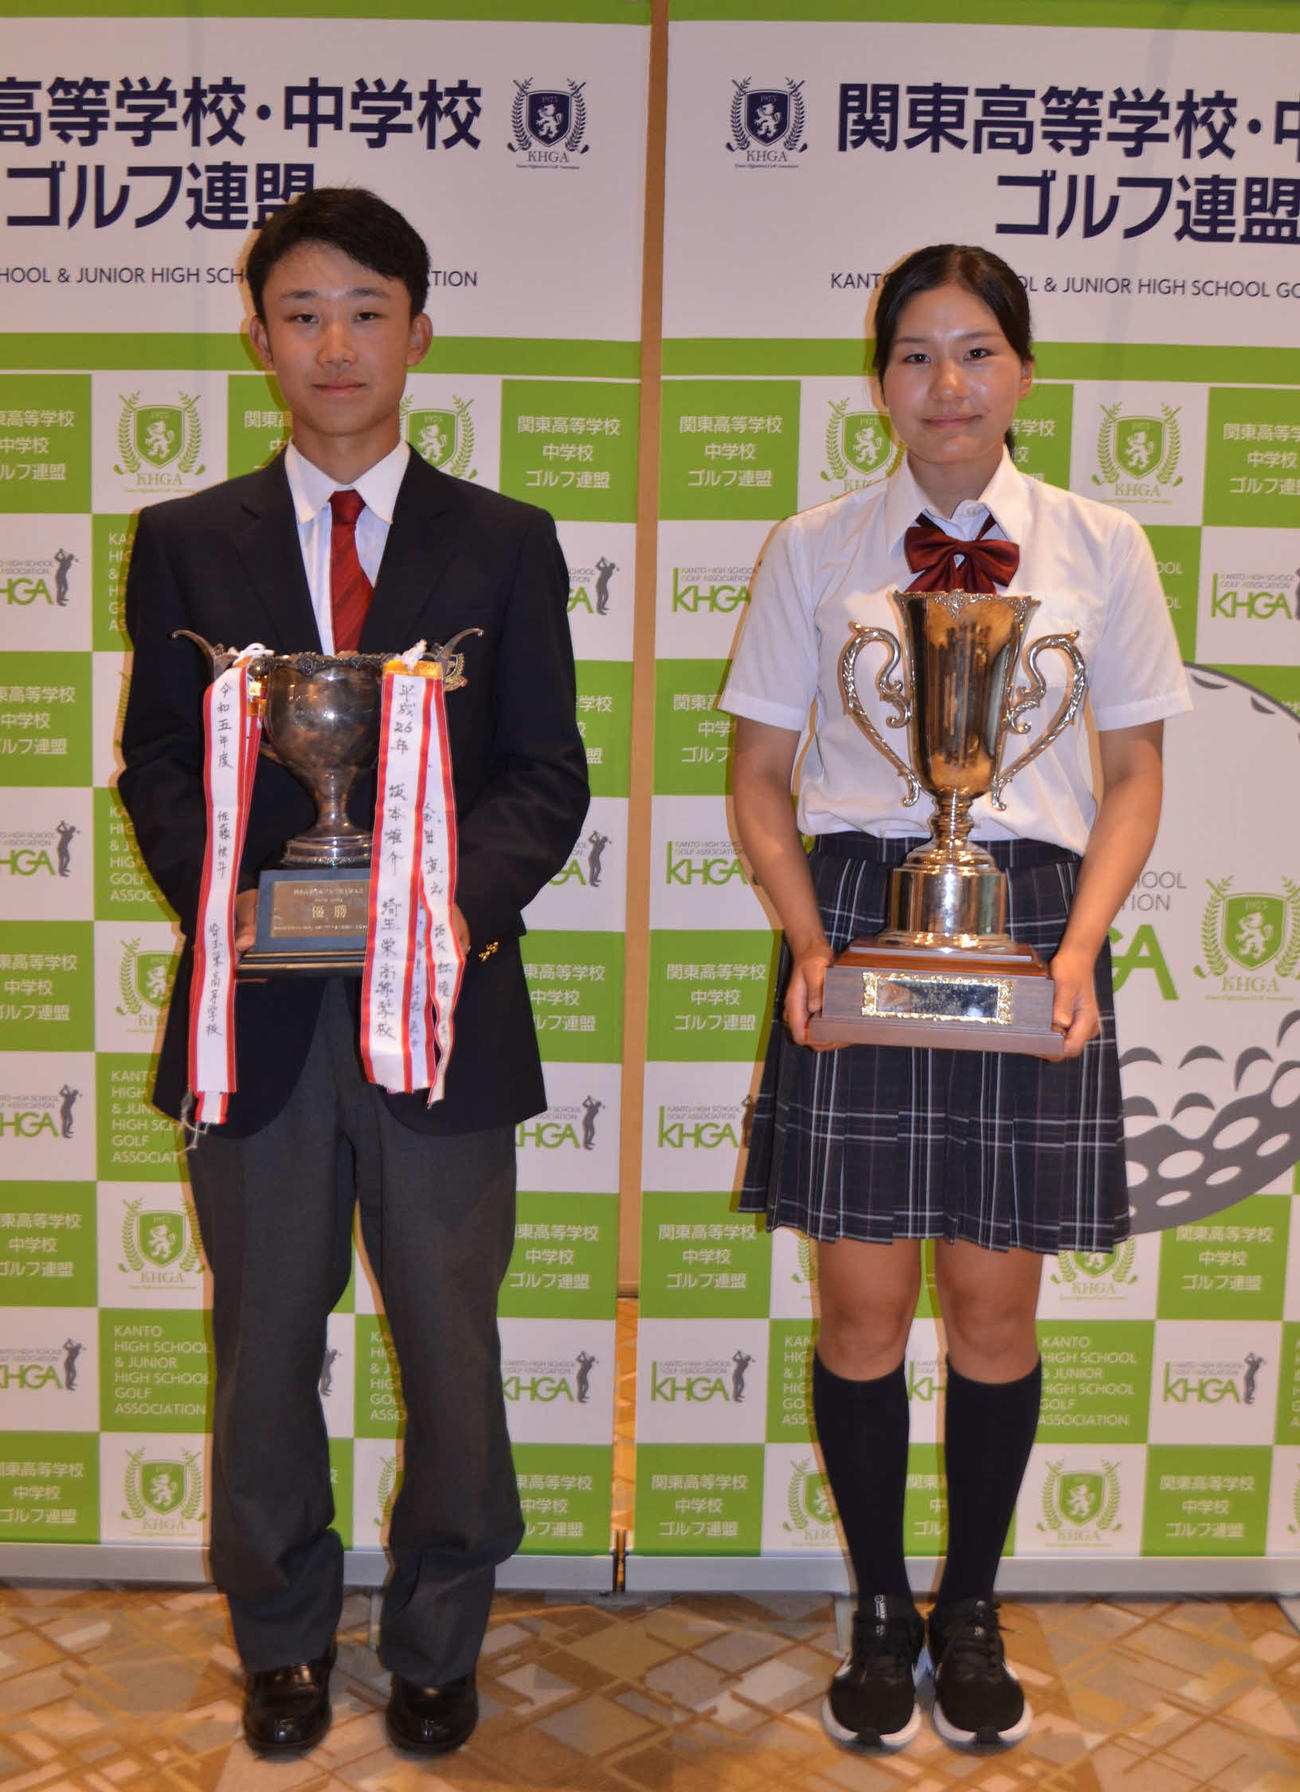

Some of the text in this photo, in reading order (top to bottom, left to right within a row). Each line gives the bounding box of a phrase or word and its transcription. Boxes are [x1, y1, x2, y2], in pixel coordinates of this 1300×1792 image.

[528, 151, 569, 162] KHGA
[747, 150, 788, 162] KHGA
[996, 169, 1300, 245] ゴルフ連盟
[57, 267, 70, 283] &
[77, 267, 144, 284] JUNIOR
[152, 267, 200, 283] HIGH
[431, 270, 477, 287] TION
[1044, 277, 1057, 292] &
[1063, 277, 1132, 293] JUNIOR
[1138, 278, 1185, 295] HIGH
[1191, 280, 1271, 297] SCHOOL
[517, 416, 621, 436] 関東高等学校
[679, 415, 783, 434] 関東高等学校
[542, 443, 594, 462] 中学校
[704, 443, 757, 461] 中学校
[1247, 451, 1298, 469] 中学校
[136, 473, 183, 486] KHGA
[525, 471, 610, 489] ゴルフ連盟
[687, 470, 773, 488] ゴルフ連盟
[1229, 476, 1300, 495] ゴルフ連
[1114, 483, 1161, 497] KHGA
[1211, 573, 1293, 620] KHGA
[576, 695, 613, 713] 学校
[2, 712, 50, 729] 中学校
[216, 681, 233, 769] 令和五年度
[666, 841, 748, 885] KHGA
[1137, 871, 1187, 889] OOL
[666, 963, 766, 980] 関東高等学校
[4, 980, 53, 996] 中学校
[1221, 976, 1279, 992] KHGA
[530, 990, 580, 1006] 中学校
[691, 990, 741, 1006] 中学校
[674, 1015, 756, 1031] ゴルフ連盟
[111, 1119, 147, 1131] HIGH
[658, 1105, 739, 1149] KHGA
[111, 1135, 150, 1147] GOLF
[658, 1224, 757, 1241] 関東高等学校
[1176, 1225, 1274, 1243] 関東高等学校
[9, 1237, 57, 1253] 中学校
[525, 1249, 574, 1265] 中学校
[682, 1248, 732, 1265] 中学校
[1199, 1250, 1247, 1267] 中学校
[141, 1272, 184, 1284] KHGA
[509, 1273, 591, 1290] ゴルフ連盟
[666, 1272, 747, 1289] ゴルフ連盟
[1181, 1275, 1262, 1291] ゴルフ連盟
[1072, 1282, 1116, 1295] KHGA
[114, 1325, 163, 1337] KANTO
[114, 1341, 209, 1353] HIGH SCHOOL
[1042, 1336, 1091, 1348] KANTO
[114, 1357, 177, 1369] & JUNIOR
[1041, 1352, 1136, 1364] HIGH SCHOOL
[114, 1373, 210, 1385] HIGH SCHOOL
[651, 1361, 730, 1402] KHGA
[1053, 1368, 1104, 1379] JUNIOR
[1079, 1383, 1135, 1395] SCHOOL
[1163, 1362, 1241, 1403] KHGA
[114, 1388, 152, 1400] GOLF
[114, 1403, 207, 1415] ASSOCIATION
[1038, 1414, 1130, 1426] ASSOCIATION
[651, 1474, 748, 1490] 関東高等学校
[1159, 1475, 1256, 1492] 関東高等学校
[13, 1485, 61, 1501] 中学校
[675, 1498, 724, 1513] 中学校
[1182, 1499, 1230, 1516] 中学校
[659, 1521, 739, 1537] ゴルフ連盟
[1165, 1523, 1245, 1540] ゴルフ連盟
